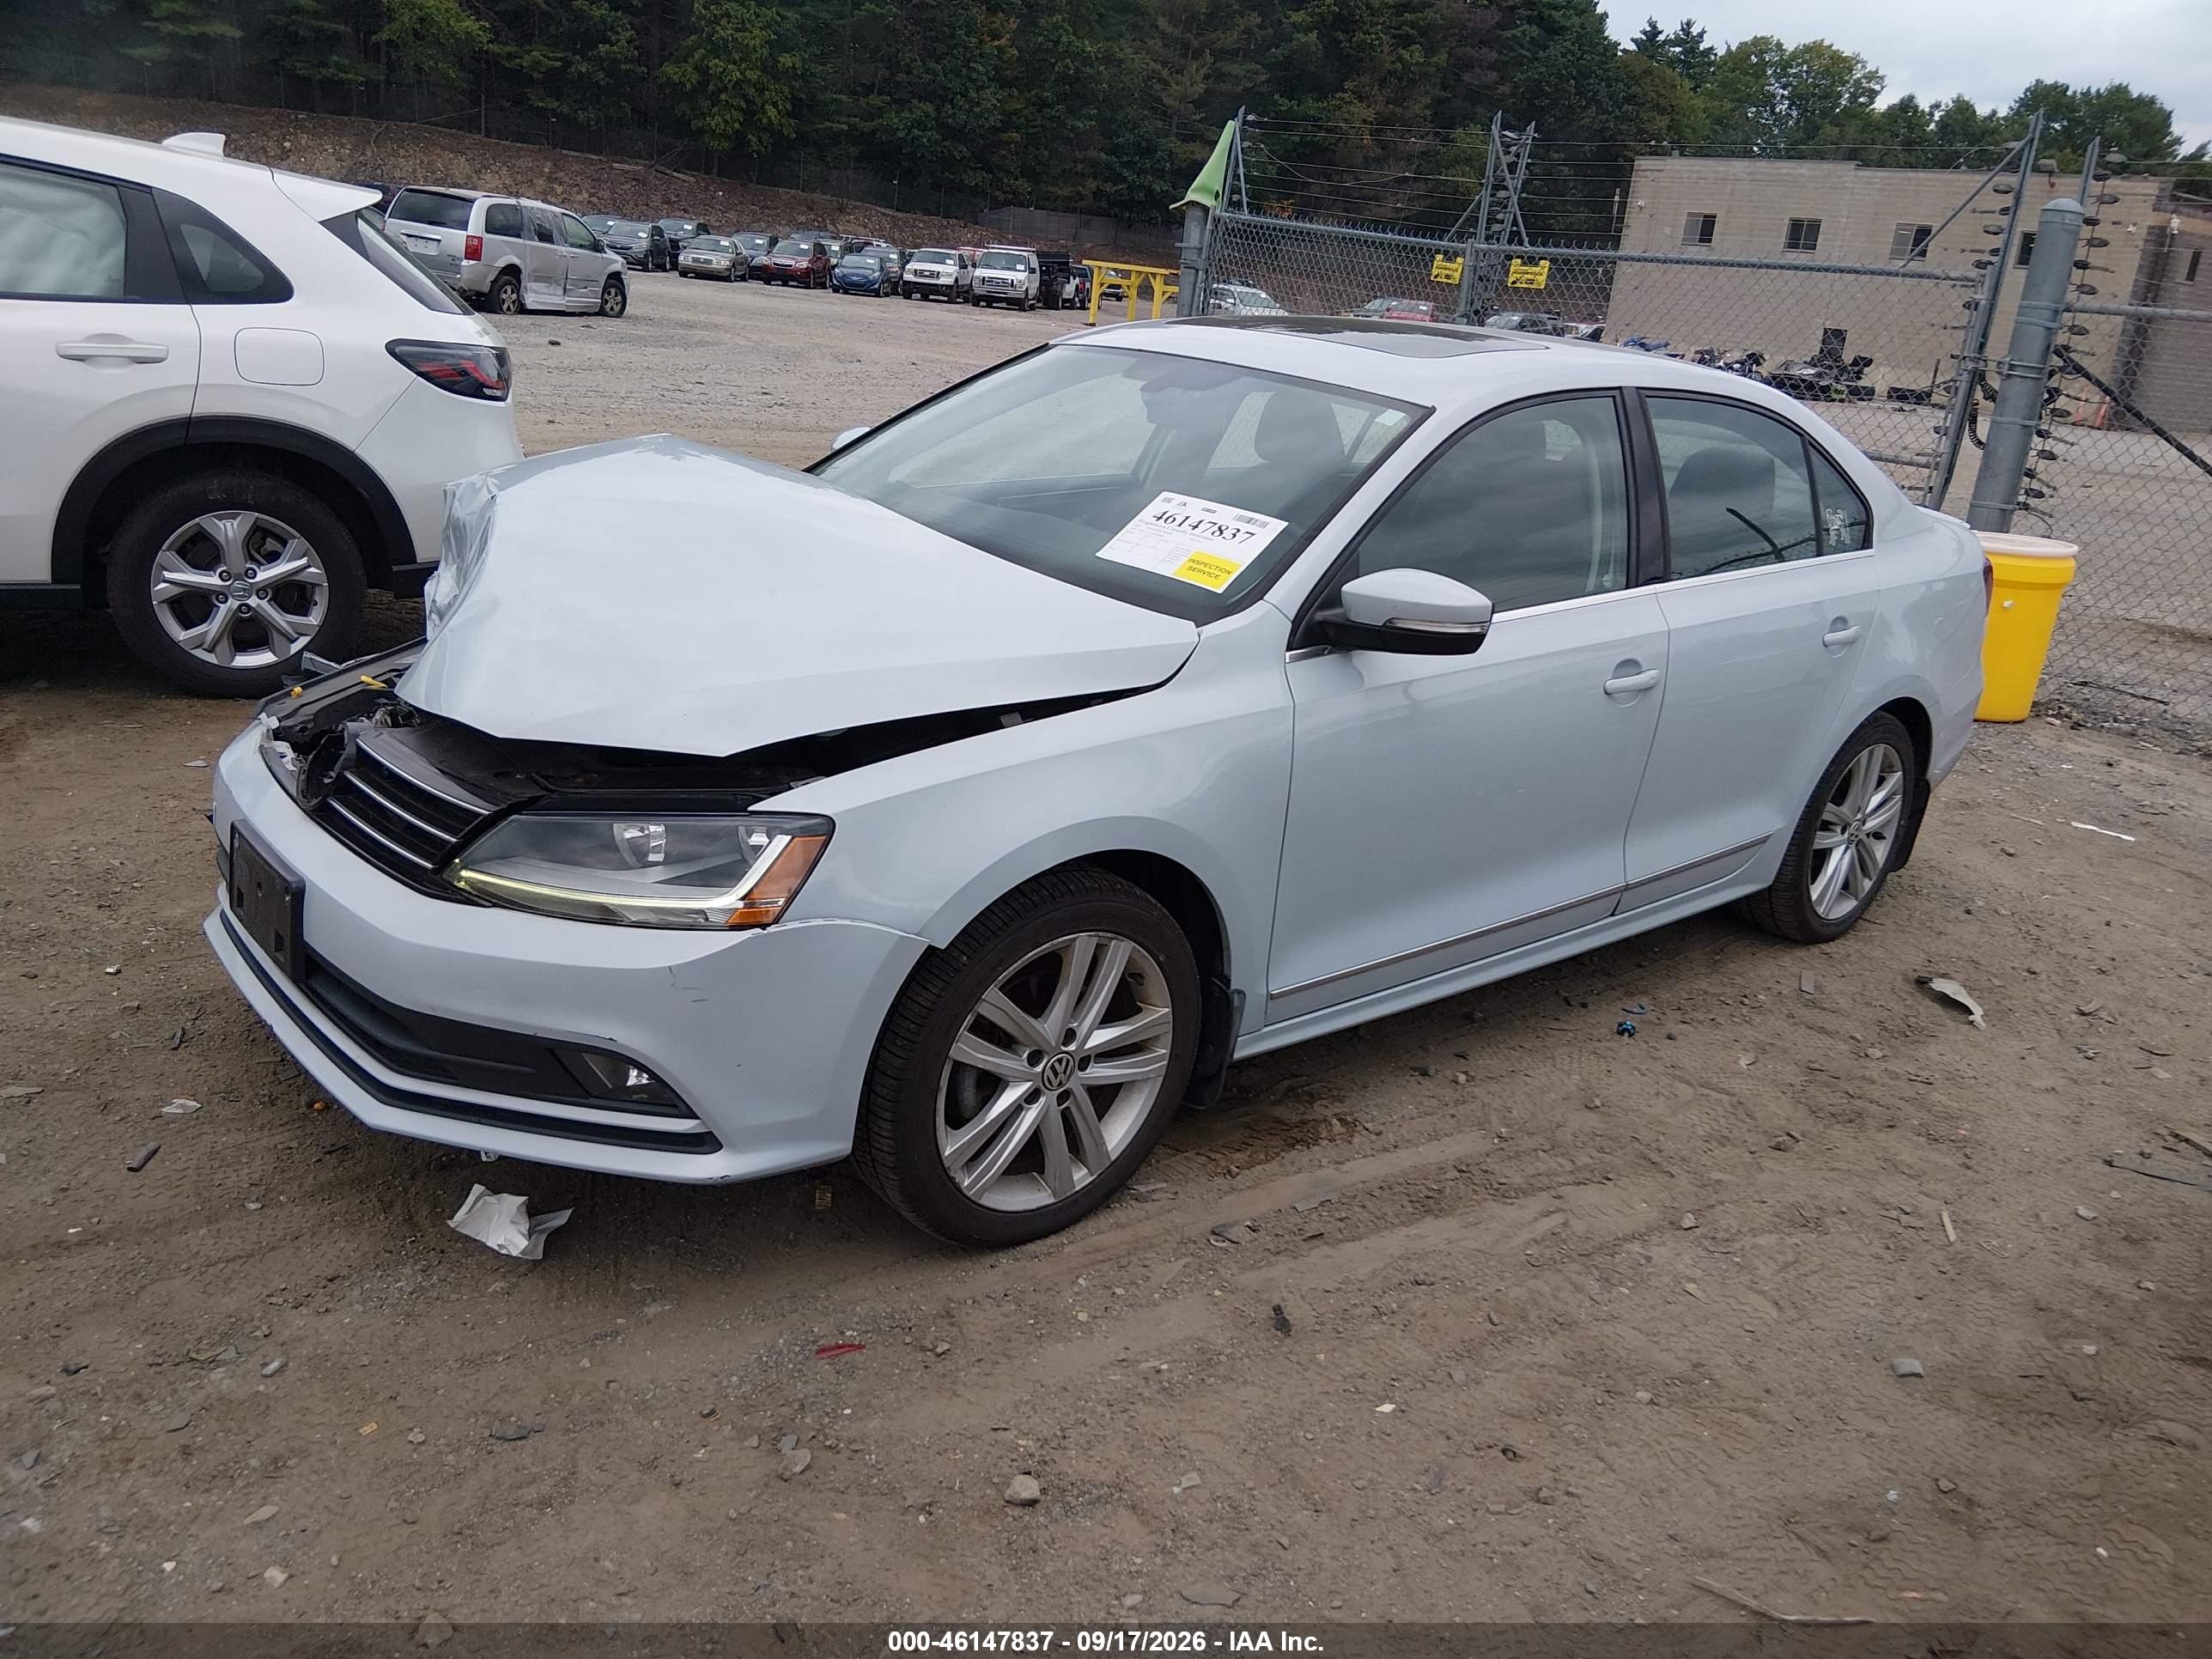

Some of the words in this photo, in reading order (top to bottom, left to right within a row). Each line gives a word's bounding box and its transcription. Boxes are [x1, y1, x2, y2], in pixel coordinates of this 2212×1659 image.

[1152, 510, 1256, 544] 46147837
[1187, 557, 1234, 575] INSPECTION
[1187, 565, 1222, 580] SERVICE
